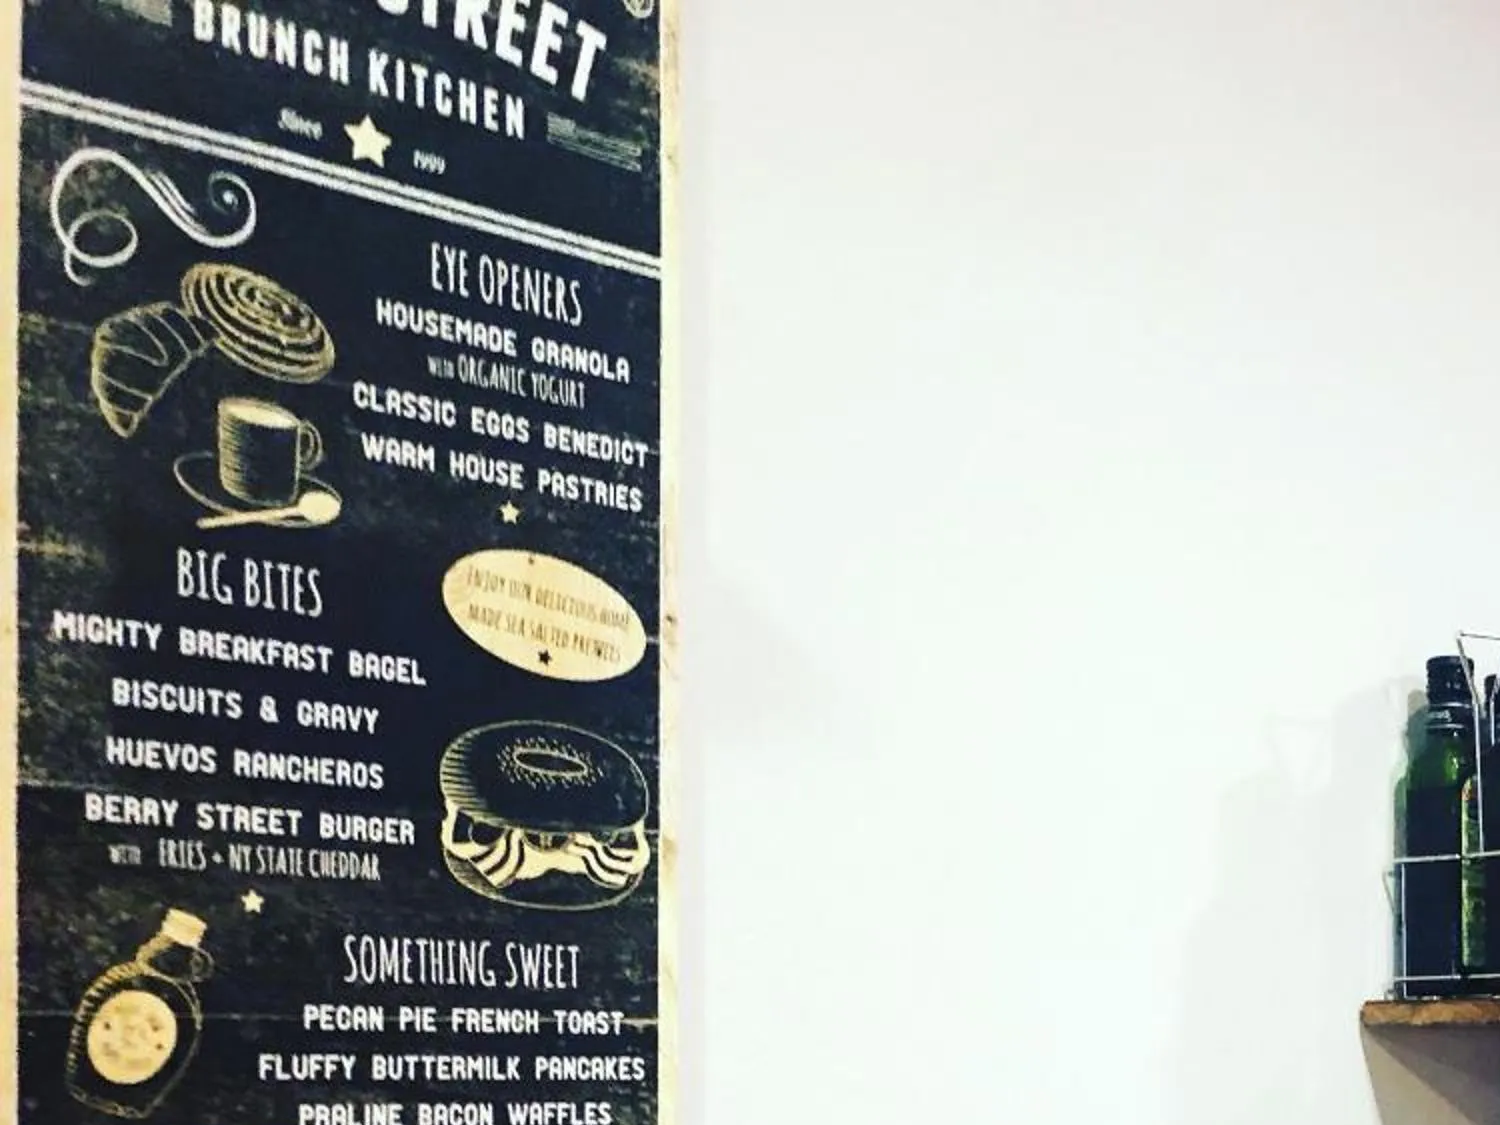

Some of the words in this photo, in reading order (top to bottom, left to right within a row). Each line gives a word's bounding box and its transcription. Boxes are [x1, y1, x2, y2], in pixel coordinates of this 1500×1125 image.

[192, 0, 350, 85] BRUNCH
[367, 47, 526, 141] KITCHEN
[378, 0, 607, 102] REET
[431, 242, 469, 298] EYE
[479, 254, 583, 327] OPENERS
[376, 298, 517, 357] HOUSEMADE
[531, 336, 630, 384] GRANOLA
[457, 353, 527, 397] ORGANIC
[531, 371, 586, 409] YOGURT
[352, 380, 457, 427] CLASSIC
[470, 407, 530, 443] EGGS
[543, 422, 650, 468] BENEDICT
[361, 432, 435, 472] WARM
[450, 450, 525, 491] HOUSE
[537, 468, 644, 513] PASTRIES
[177, 546, 234, 606] BIG
[244, 557, 324, 617] BITES
[51, 610, 162, 651] MIGHTY
[180, 627, 333, 673] BREAKFAST
[349, 650, 427, 687] BAGEL
[112, 678, 243, 719] BISCUITS
[259, 696, 279, 722] &
[297, 700, 379, 735] GRAVY
[105, 735, 218, 774] HUEVOS
[233, 749, 384, 790] RANCHEROS
[85, 793, 179, 827] BERRY
[197, 803, 302, 836] STREET
[319, 812, 415, 845] BURGER
[229, 843, 250, 873] NY
[256, 845, 302, 877] STATE
[308, 849, 381, 881] CHEDDAR
[343, 934, 496, 988] SOMETHING
[504, 941, 581, 989] SWEET
[303, 1004, 385, 1032] PECAN
[399, 1006, 437, 1033] PIE
[451, 1007, 539, 1034] FRENCH
[554, 1010, 625, 1036] TOAST
[258, 1053, 356, 1081] FLUFFY
[371, 1054, 520, 1081] BUTTERMILK
[535, 1056, 646, 1081] PANCAKES
